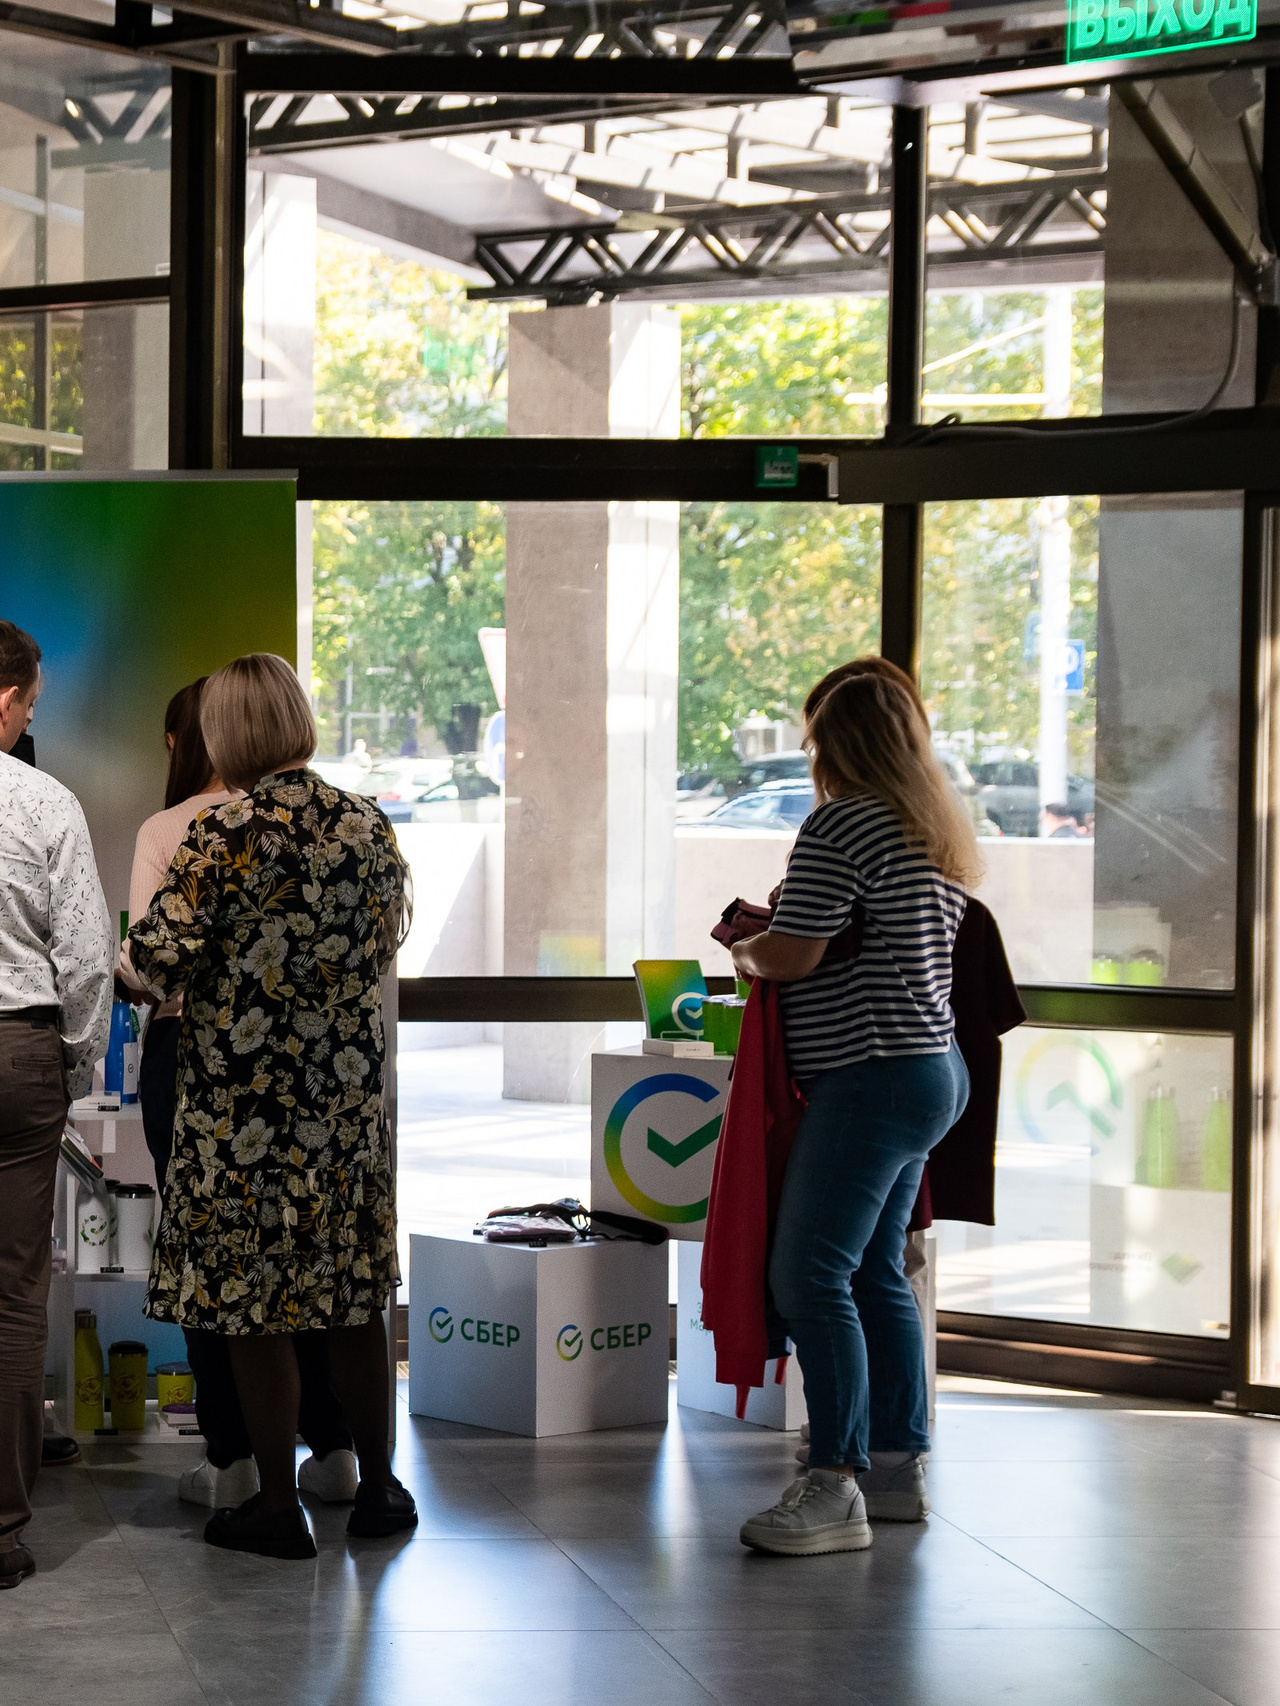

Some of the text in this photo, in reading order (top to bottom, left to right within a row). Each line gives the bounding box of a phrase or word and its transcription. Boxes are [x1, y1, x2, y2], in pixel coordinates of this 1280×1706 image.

[1075, 0, 1252, 49] ВЫХОД
[460, 1317, 521, 1348] СБЕР
[590, 1322, 652, 1351] СБЕР
